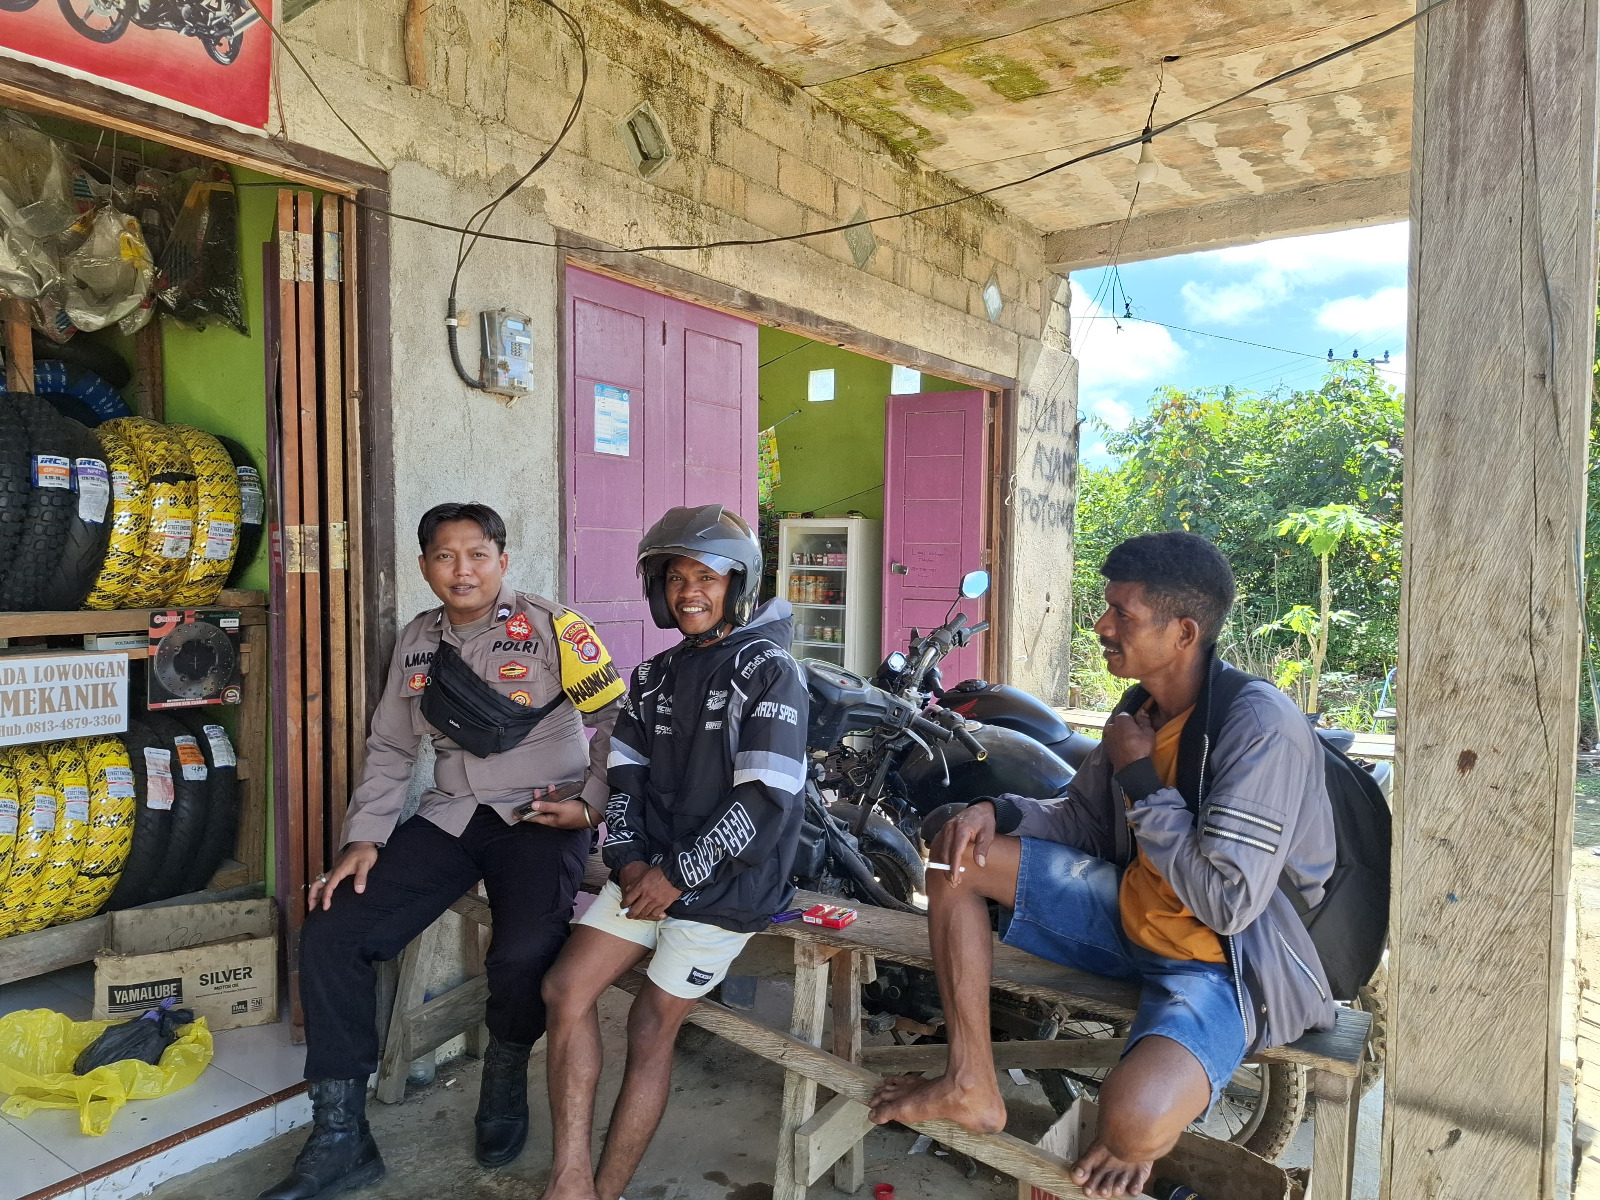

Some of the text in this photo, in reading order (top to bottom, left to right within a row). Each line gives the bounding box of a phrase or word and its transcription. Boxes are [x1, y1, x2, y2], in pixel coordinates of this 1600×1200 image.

[492, 640, 539, 655] POLRI
[0, 660, 127, 686] DA LOWONGAN
[0, 681, 119, 719] MEKANIK
[778, 704, 798, 726] SPEED
[199, 966, 253, 986] SILVER
[113, 983, 178, 1004] YAMALUBE
